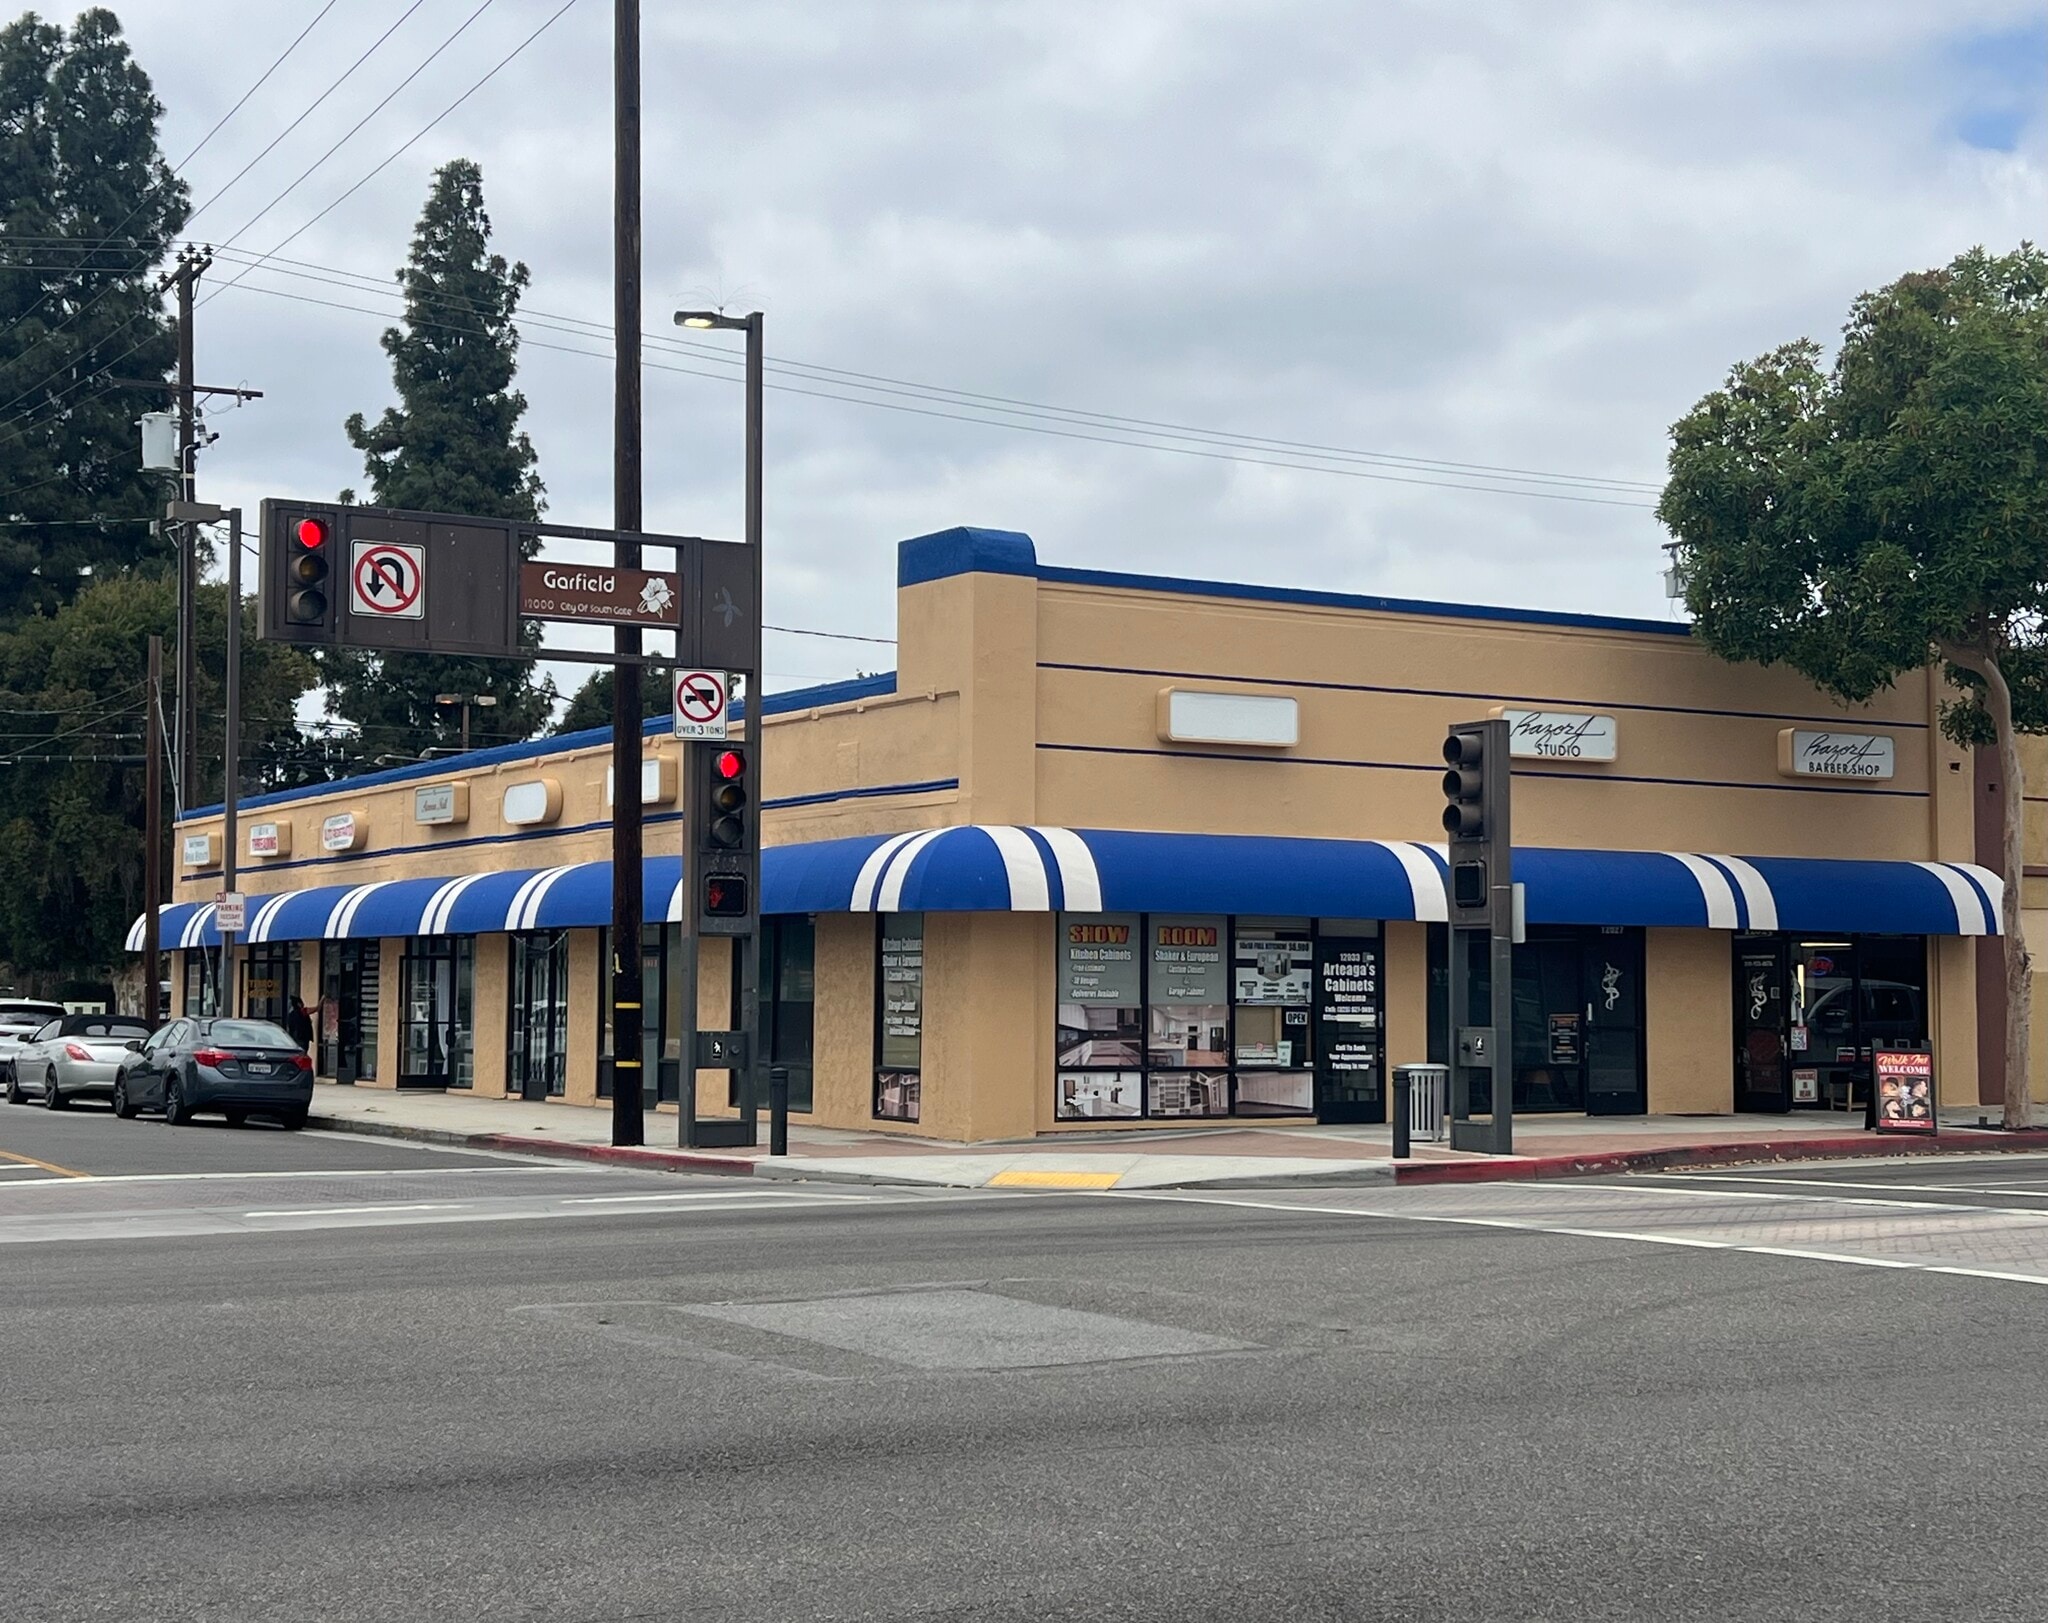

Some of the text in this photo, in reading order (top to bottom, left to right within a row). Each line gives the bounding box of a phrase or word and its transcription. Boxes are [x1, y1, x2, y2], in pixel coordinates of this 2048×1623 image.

[543, 571, 615, 593] Garfield
[560, 602, 577, 614] City
[590, 604, 612, 614] South
[613, 605, 632, 616] Gate
[678, 725, 724, 735] OVER 3 TONS
[1536, 743, 1581, 757] STUDIO
[1069, 925, 1129, 944] SHOW
[1159, 927, 1217, 946] ROOM
[1070, 948, 1131, 960] Kitchen Cabinets
[1155, 950, 1180, 961] Shaker
[1186, 951, 1219, 963] European
[1323, 963, 1375, 977] Arteaga's
[1325, 978, 1374, 992] Cabinets
[1287, 1013, 1306, 1023] OPEN
[1878, 1065, 1930, 1074] WELCOME
